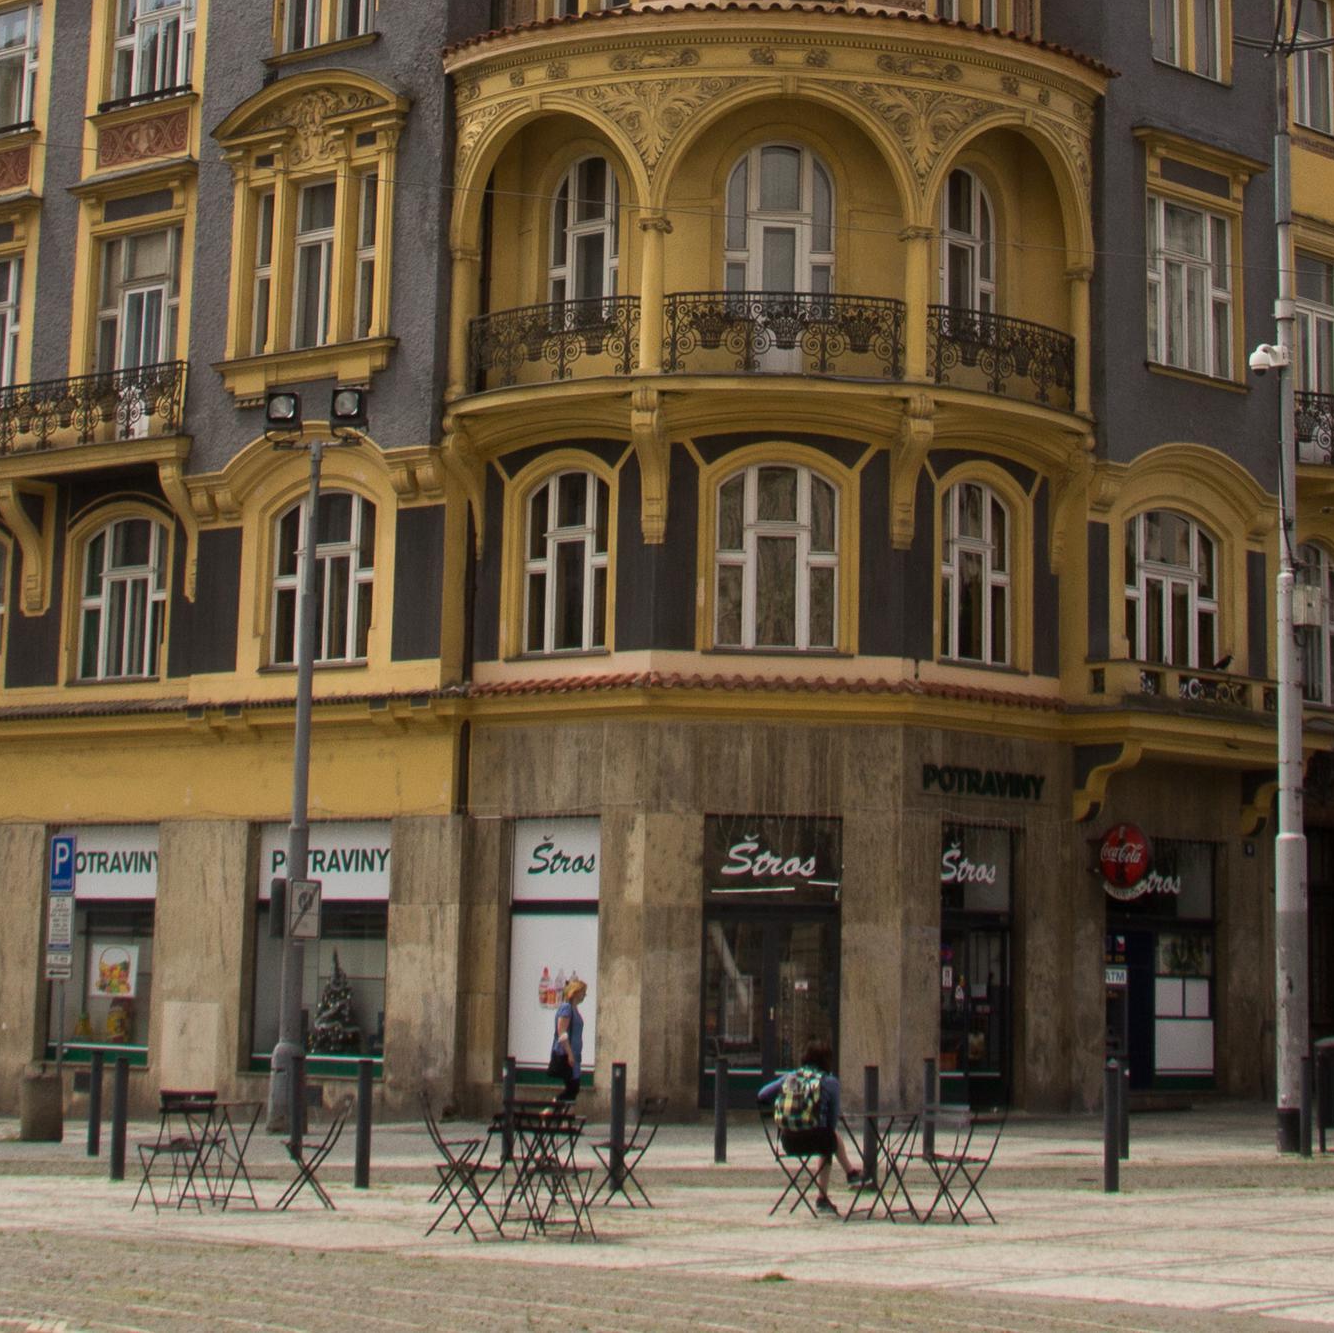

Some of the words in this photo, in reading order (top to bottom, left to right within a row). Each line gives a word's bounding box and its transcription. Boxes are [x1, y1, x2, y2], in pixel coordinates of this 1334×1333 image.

[923, 764, 1046, 801] POTRAVINY
[55, 842, 70, 875] P
[527, 833, 596, 875] Štros
[721, 833, 816, 877] Štros
[940, 842, 996, 884] Štros
[1145, 870, 1182, 895] tros
